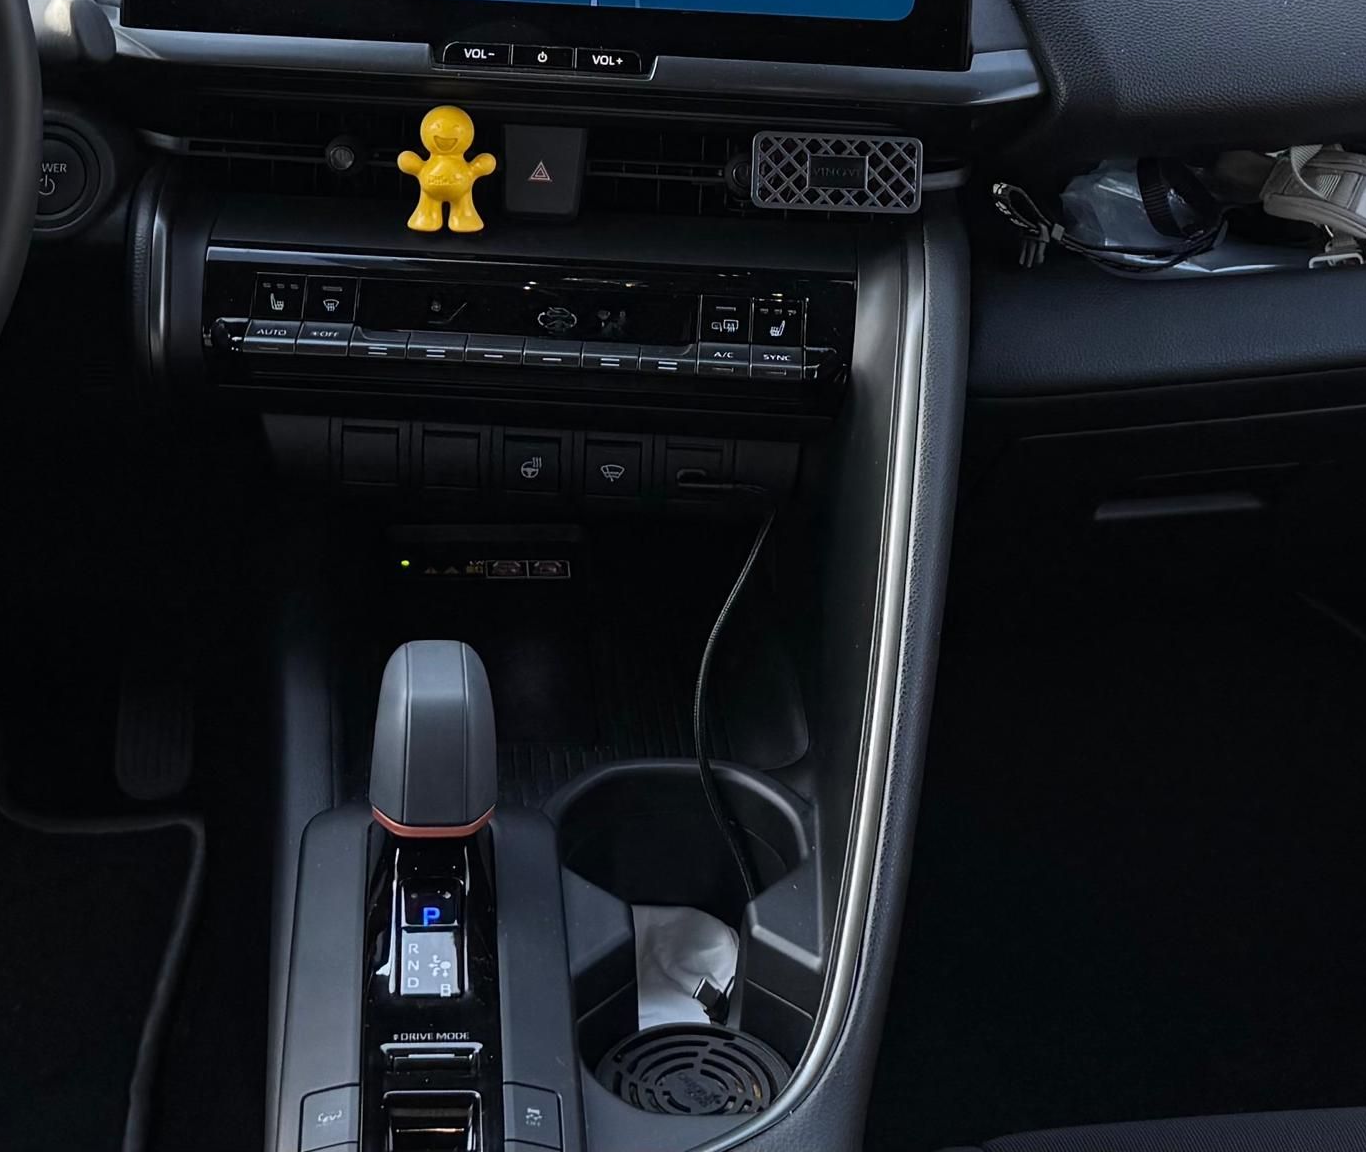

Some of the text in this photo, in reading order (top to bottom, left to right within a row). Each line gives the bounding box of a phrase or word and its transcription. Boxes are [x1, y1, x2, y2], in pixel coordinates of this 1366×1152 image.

[42, 163, 67, 173] WER
[257, 328, 287, 336] AUTO
[423, 907, 440, 926] P
[408, 943, 419, 954] R
[408, 960, 419, 970] N
[408, 977, 419, 988] D
[441, 984, 451, 997] B
[400, 1031, 469, 1041] DRIVE MODE
